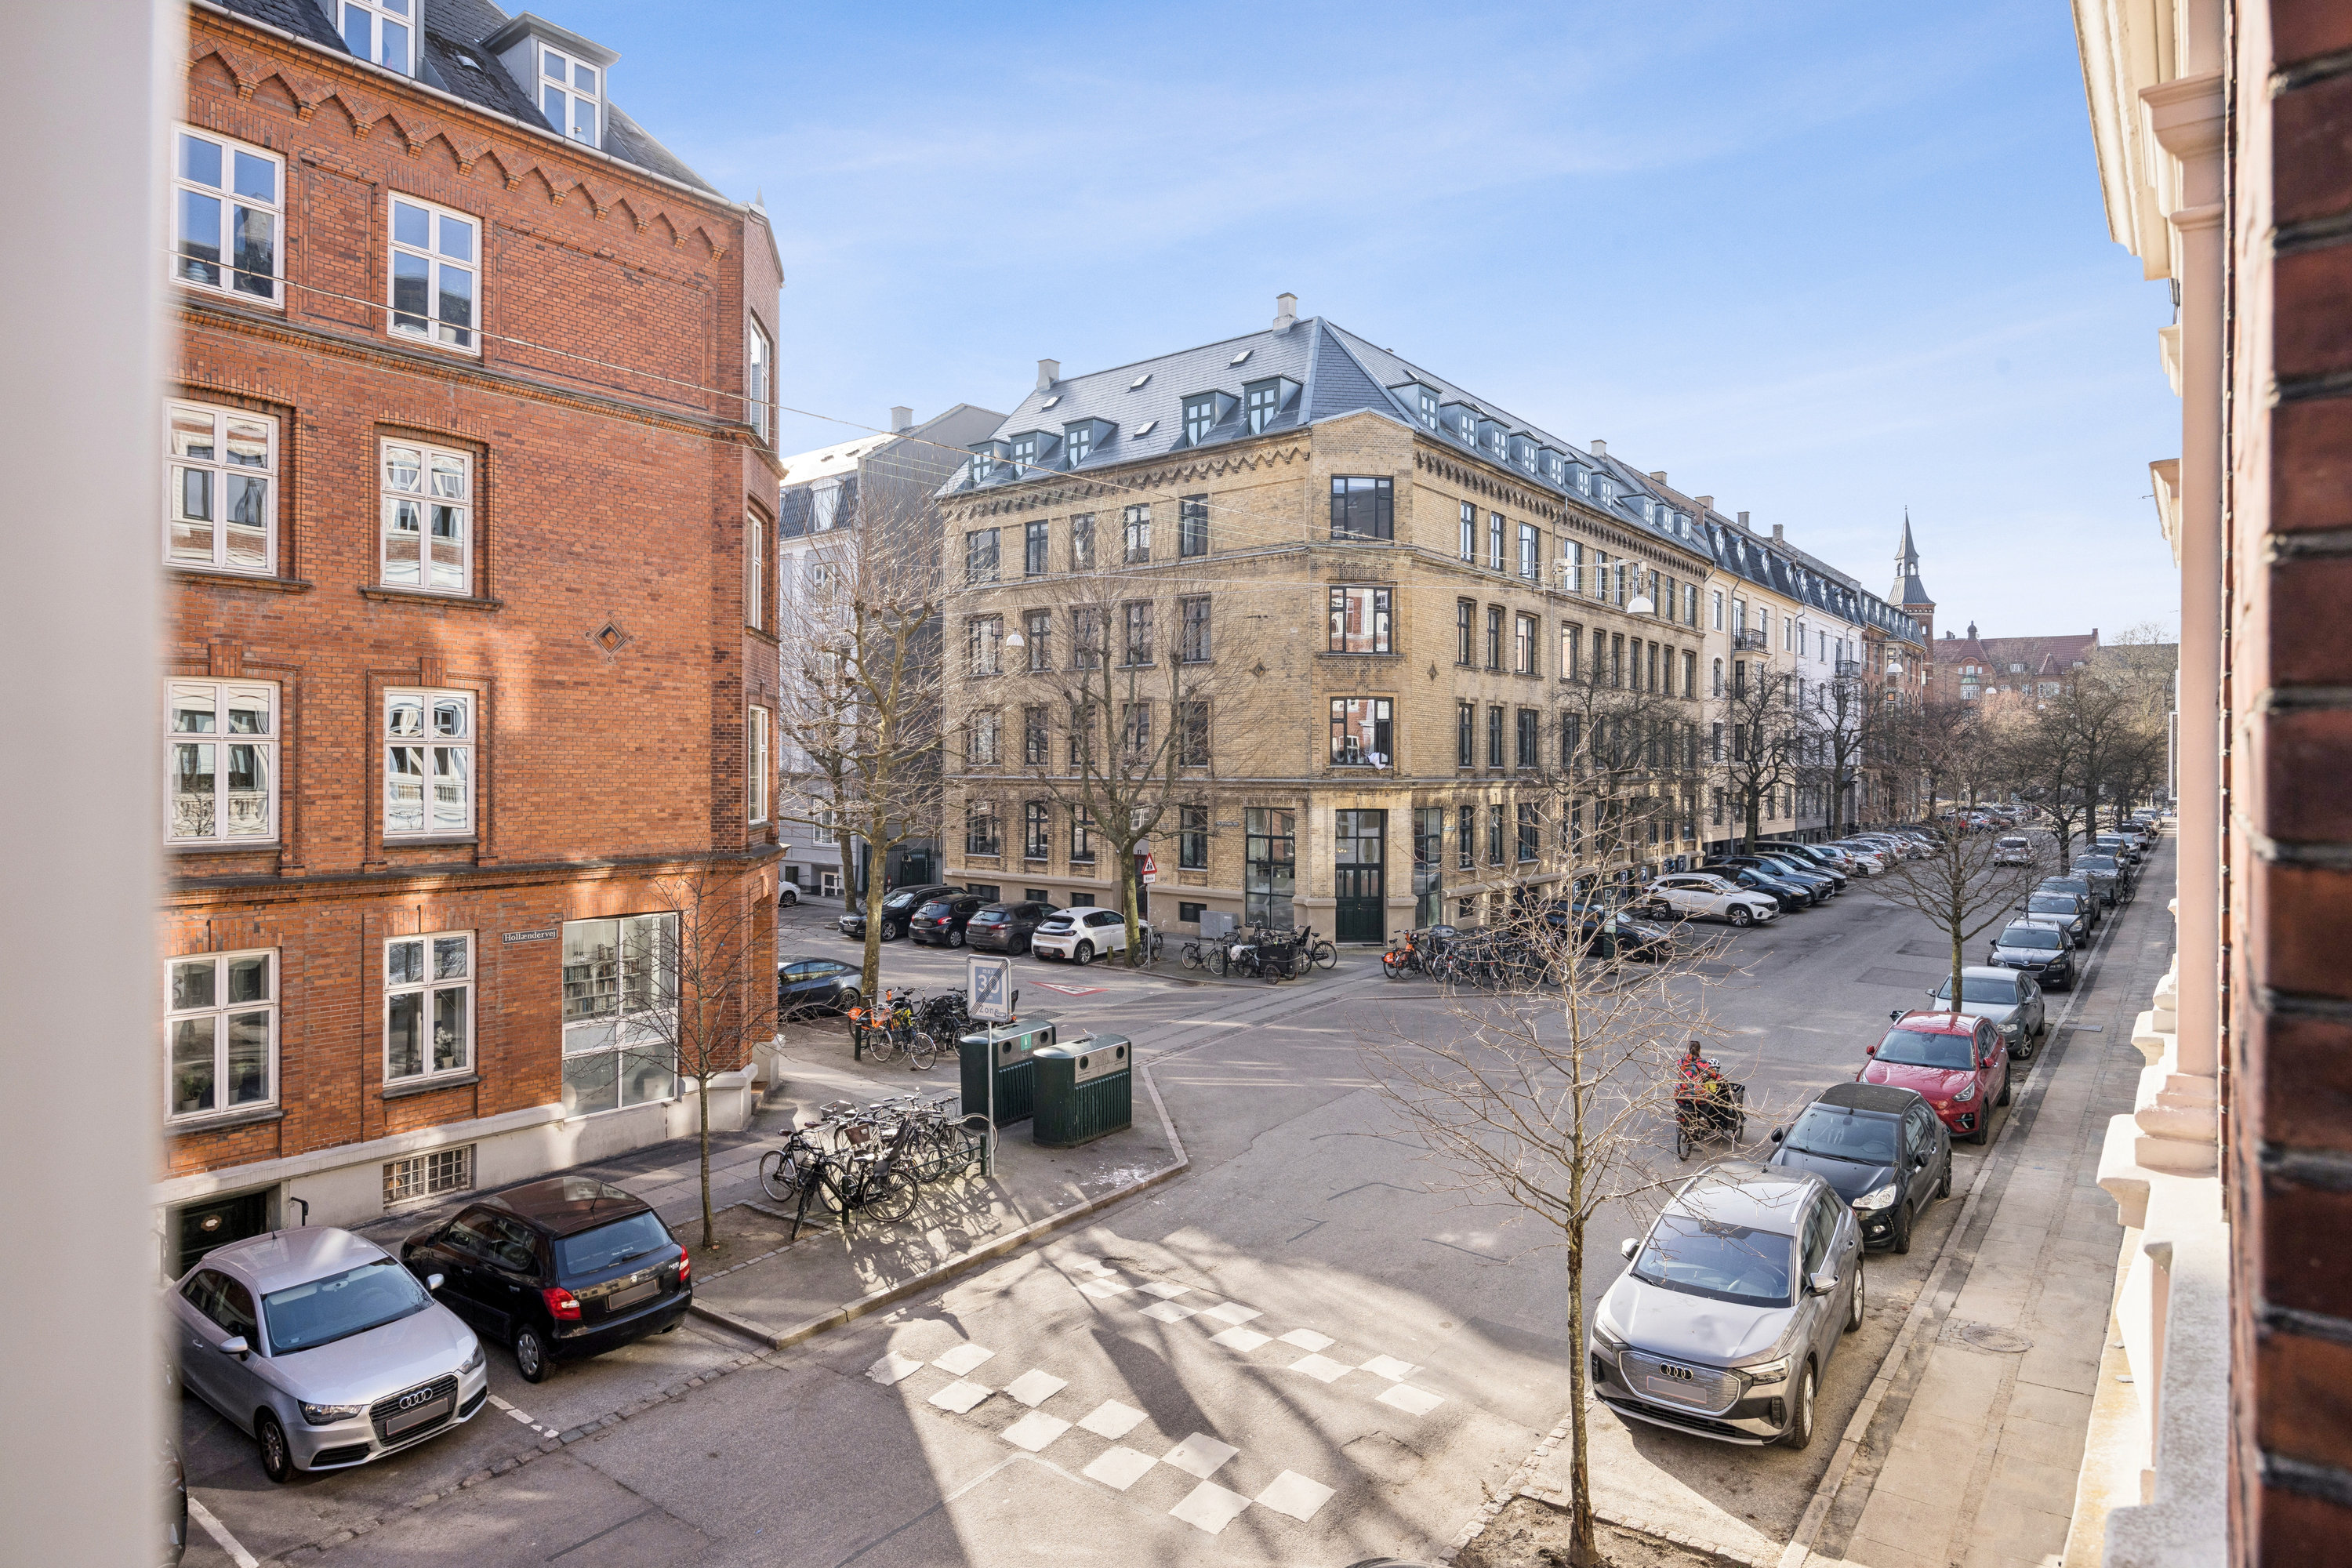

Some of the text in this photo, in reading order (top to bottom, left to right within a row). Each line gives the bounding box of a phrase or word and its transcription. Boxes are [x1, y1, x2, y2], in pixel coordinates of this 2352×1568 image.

[1605, 889, 1613, 900] P
[505, 930, 556, 942] Hollændervej
[978, 974, 1000, 994] 30
[979, 1005, 999, 1014] Zone
